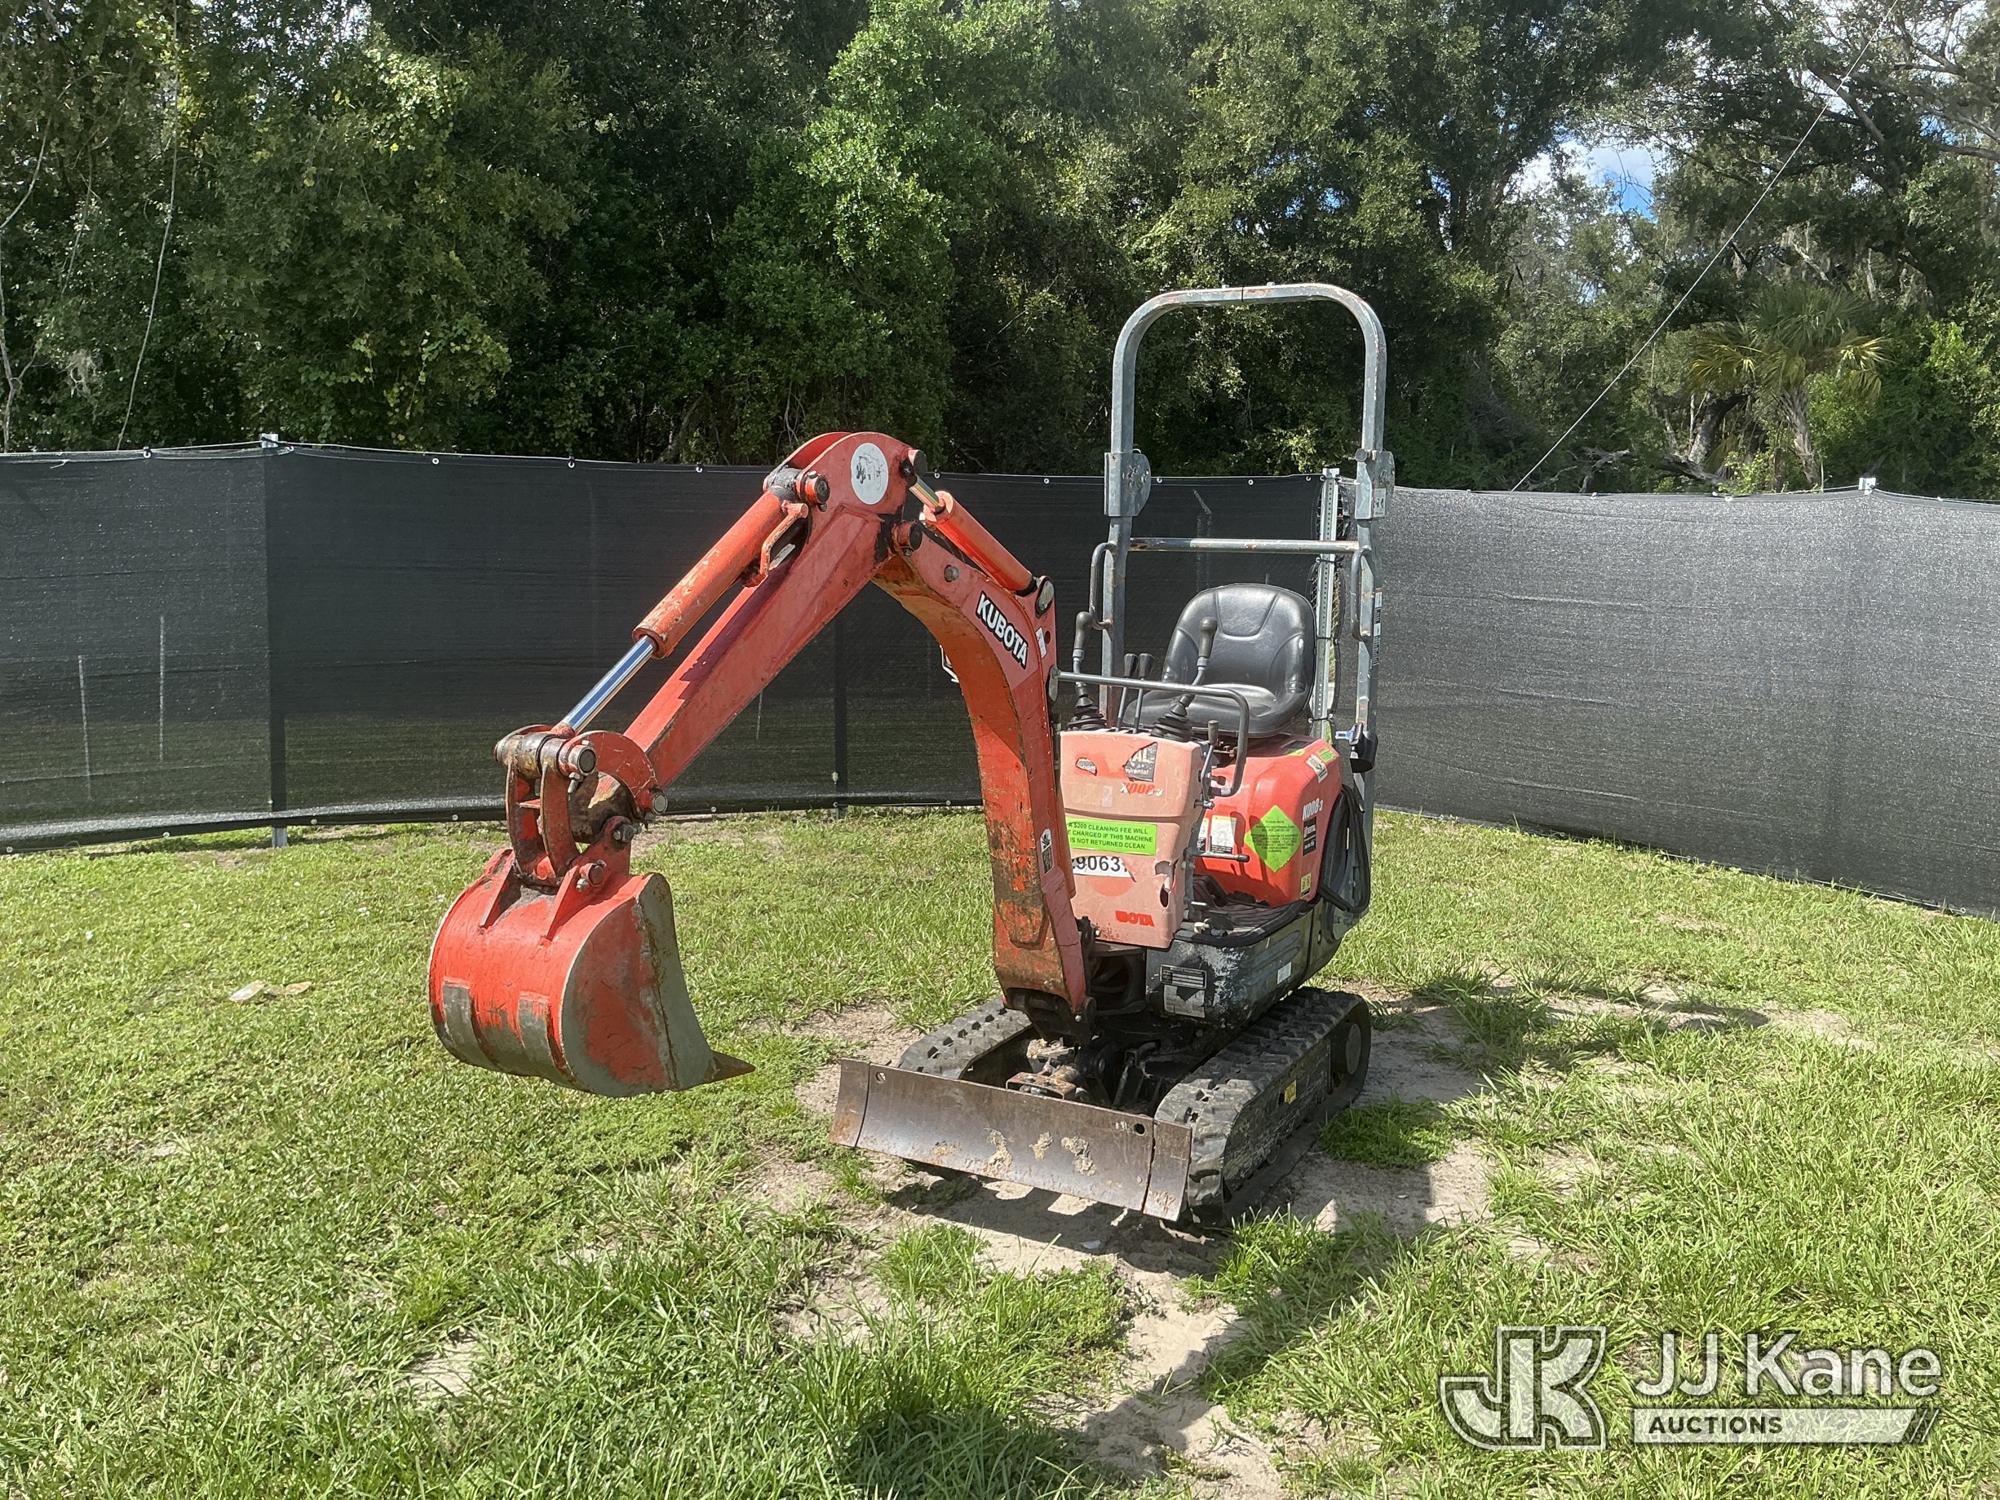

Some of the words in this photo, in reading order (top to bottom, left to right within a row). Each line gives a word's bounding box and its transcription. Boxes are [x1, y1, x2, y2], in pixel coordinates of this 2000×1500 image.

[976, 592, 1028, 668] KUBOTA
[1088, 824, 1119, 833] CLEANING
[1072, 830, 1102, 839] CHARGED
[1110, 833, 1124, 841] THIS
[1125, 835, 1153, 843] MACHINE
[1090, 838, 1123, 848] RETURNED
